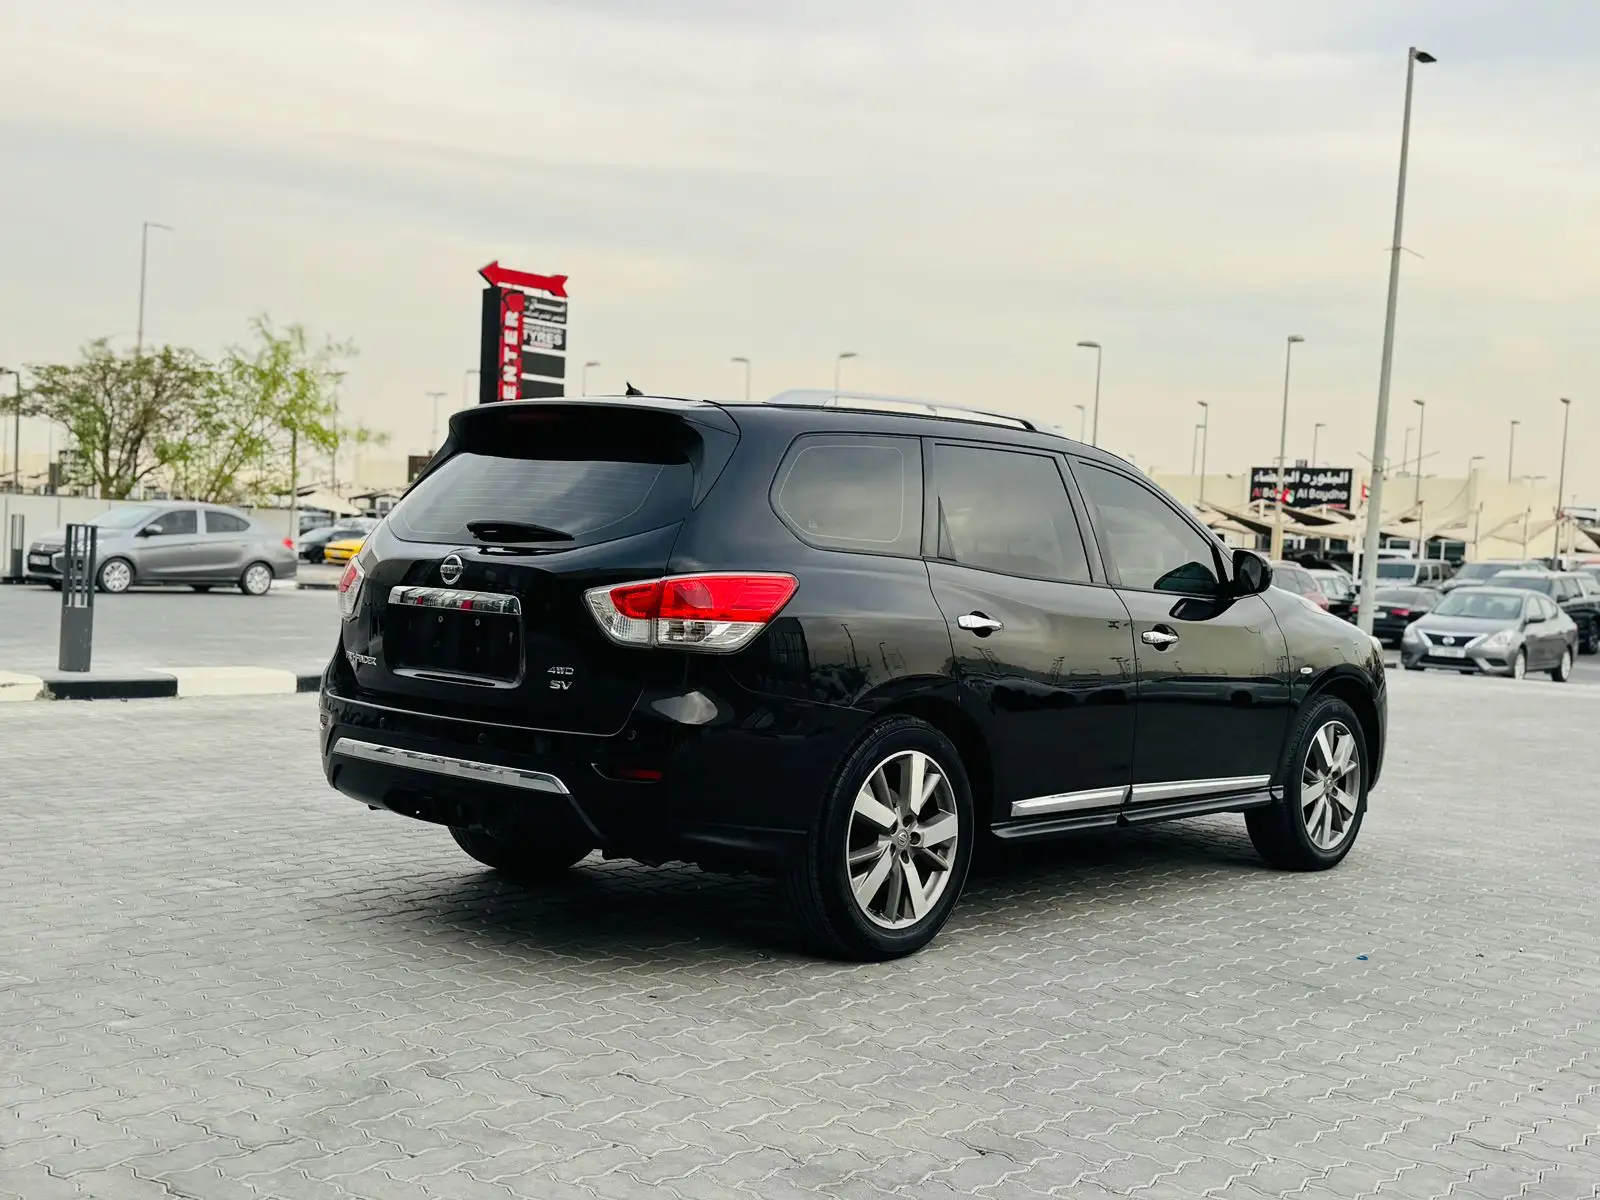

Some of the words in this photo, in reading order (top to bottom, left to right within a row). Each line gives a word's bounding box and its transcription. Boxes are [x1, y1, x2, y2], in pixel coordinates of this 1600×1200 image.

[1296, 488, 1307, 498] Al
[547, 666, 575, 675] 4WD
[549, 680, 573, 690] SV
